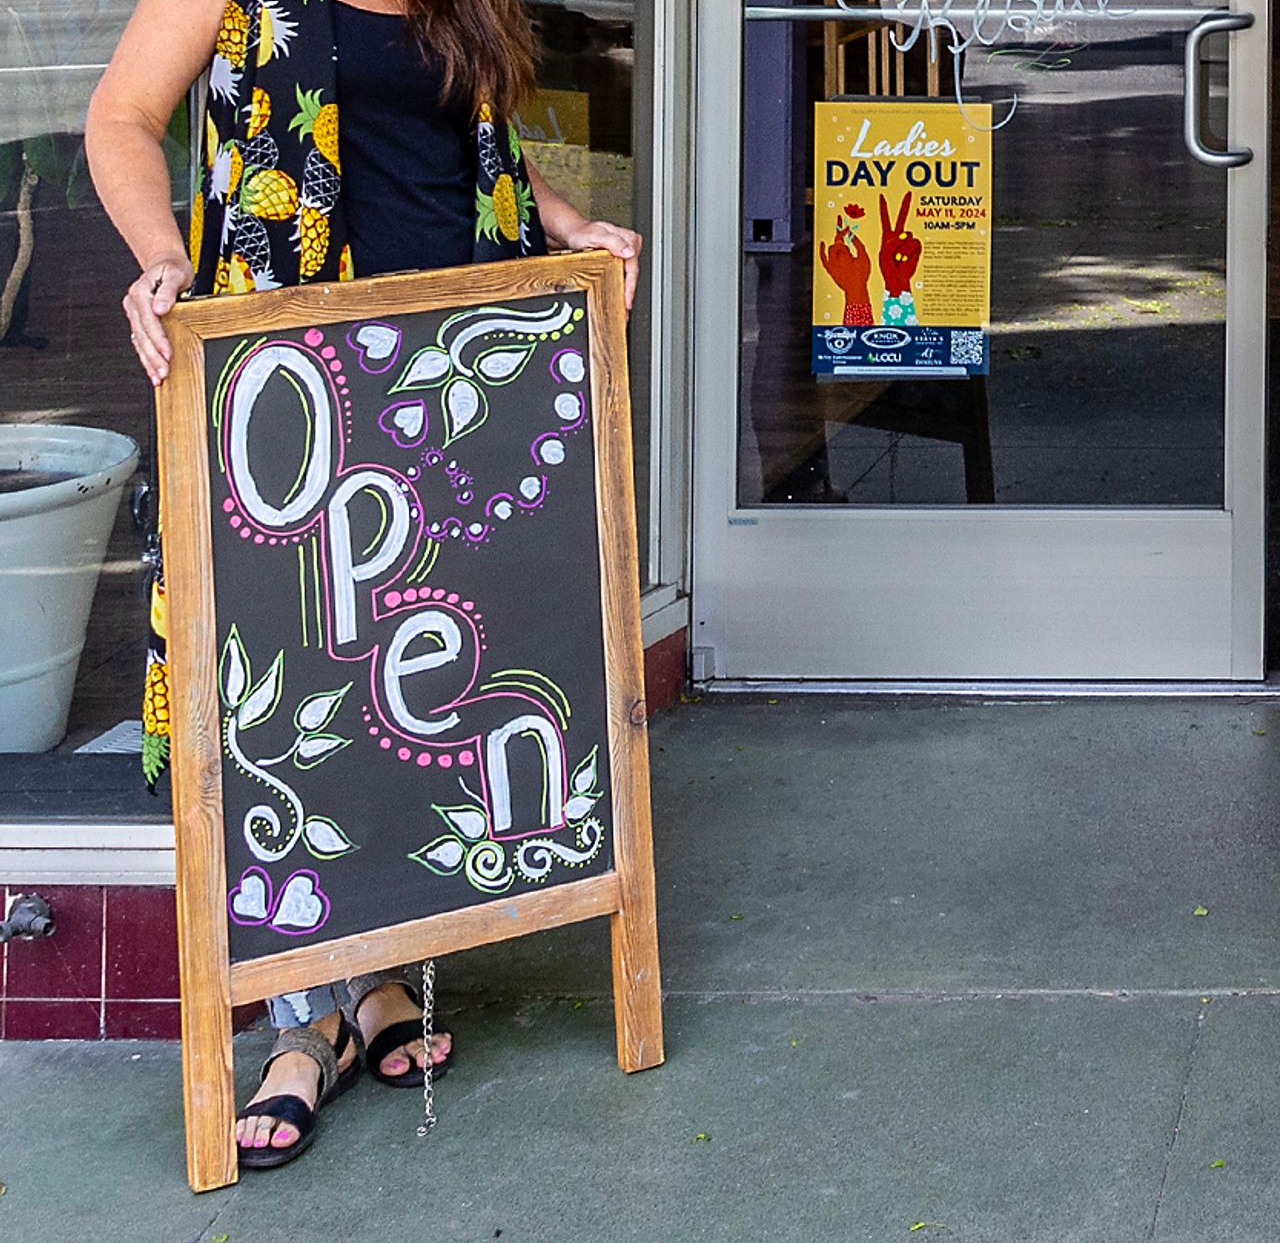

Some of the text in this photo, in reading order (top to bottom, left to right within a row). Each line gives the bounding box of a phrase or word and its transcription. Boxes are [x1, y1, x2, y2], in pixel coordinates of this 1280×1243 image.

[850, 118, 957, 159] Ladies
[826, 160, 981, 188] DAY OUT
[920, 196, 983, 206] SATURDAY
[916, 208, 987, 219] MAY 11, 2024
[924, 221, 976, 230] 10AM-5PM
[230, 344, 573, 832] Open
